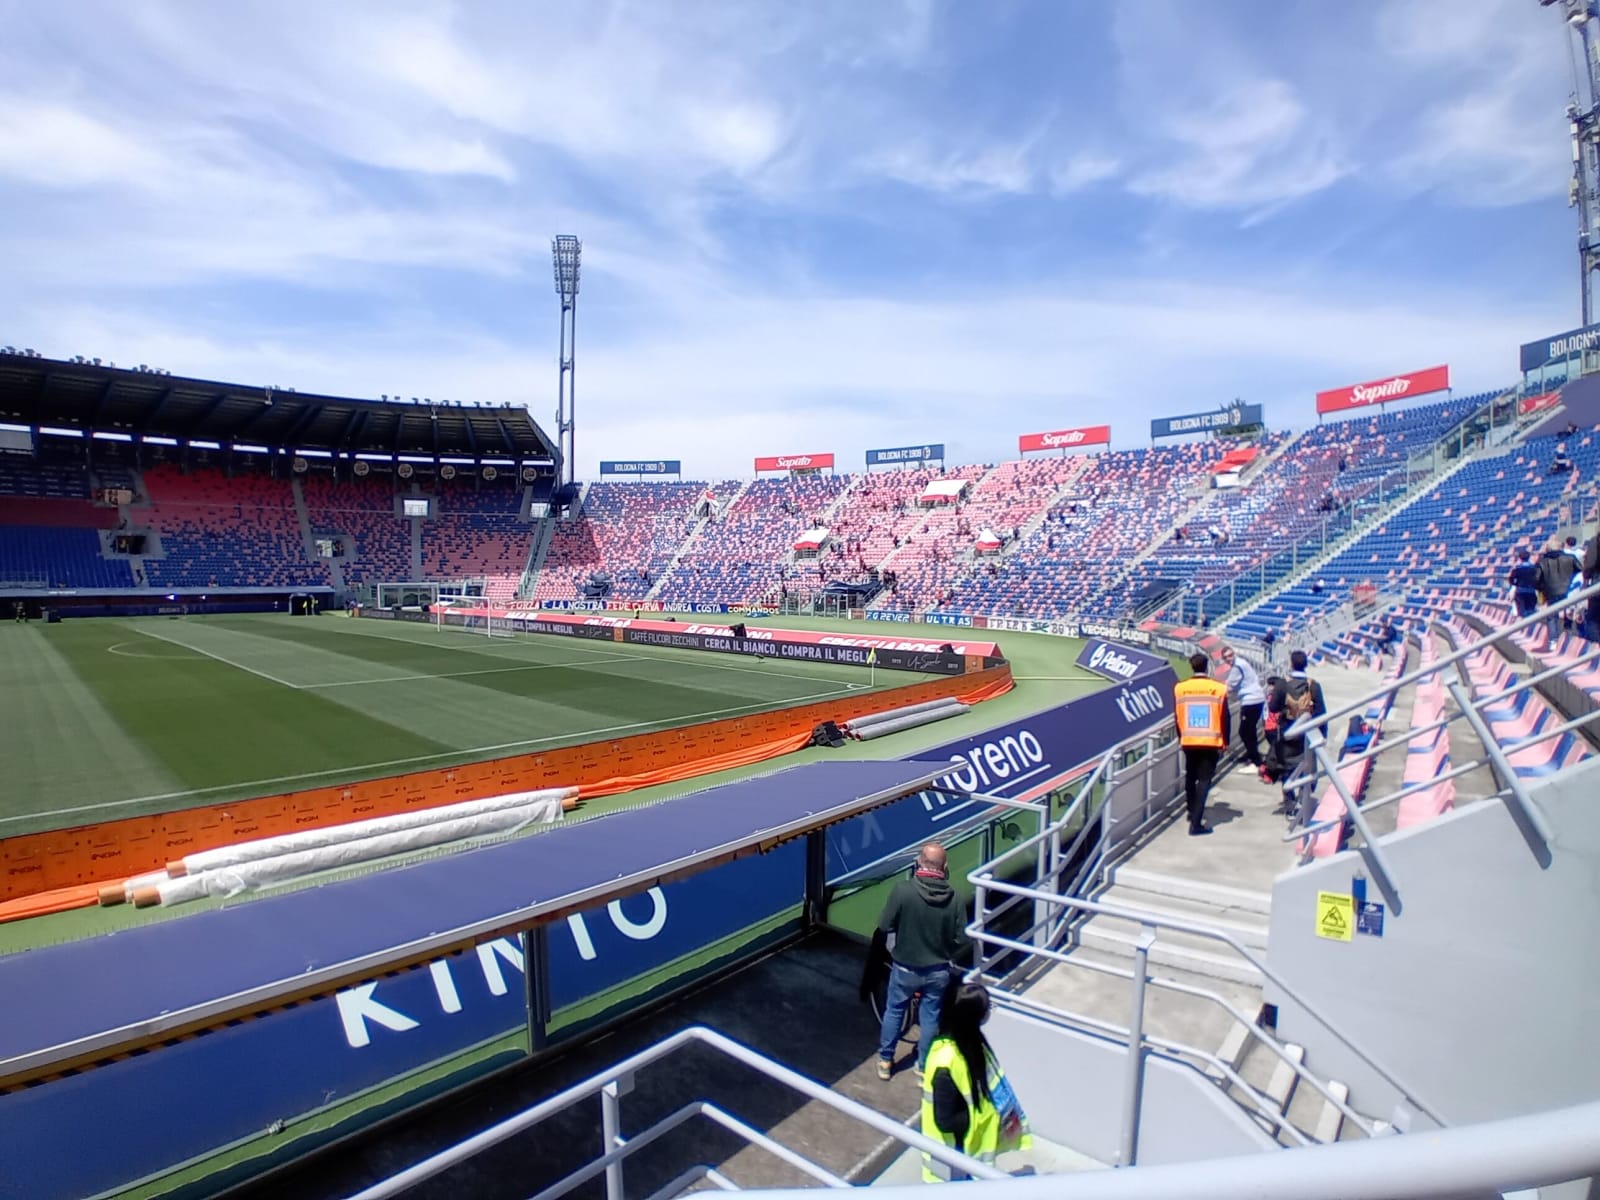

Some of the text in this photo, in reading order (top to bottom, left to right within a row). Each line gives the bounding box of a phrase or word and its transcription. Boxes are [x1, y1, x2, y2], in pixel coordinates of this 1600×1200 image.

[1350, 378, 1411, 404] Saputo
[1170, 411, 1229, 431] BOLOGNA FC 1909
[1041, 430, 1086, 448] Saputo
[776, 455, 812, 467] Saputo
[877, 449, 900, 461] BOLOGNA
[901, 448, 908, 458] FC
[614, 463, 637, 472] BOLOGNA
[569, 600, 604, 611] NOSTRA
[606, 600, 630, 611] FEDE
[663, 601, 693, 612] ANDREA
[696, 602, 721, 613] COSTA
[926, 614, 971, 626] ULTRAS
[705, 638, 731, 650] CERCA
[733, 641, 742, 652] IL
[744, 641, 780, 656] BIANCO,
[782, 644, 821, 659] COMPRA
[824, 648, 835, 660] IL
[1116, 685, 1164, 722] KINTO
